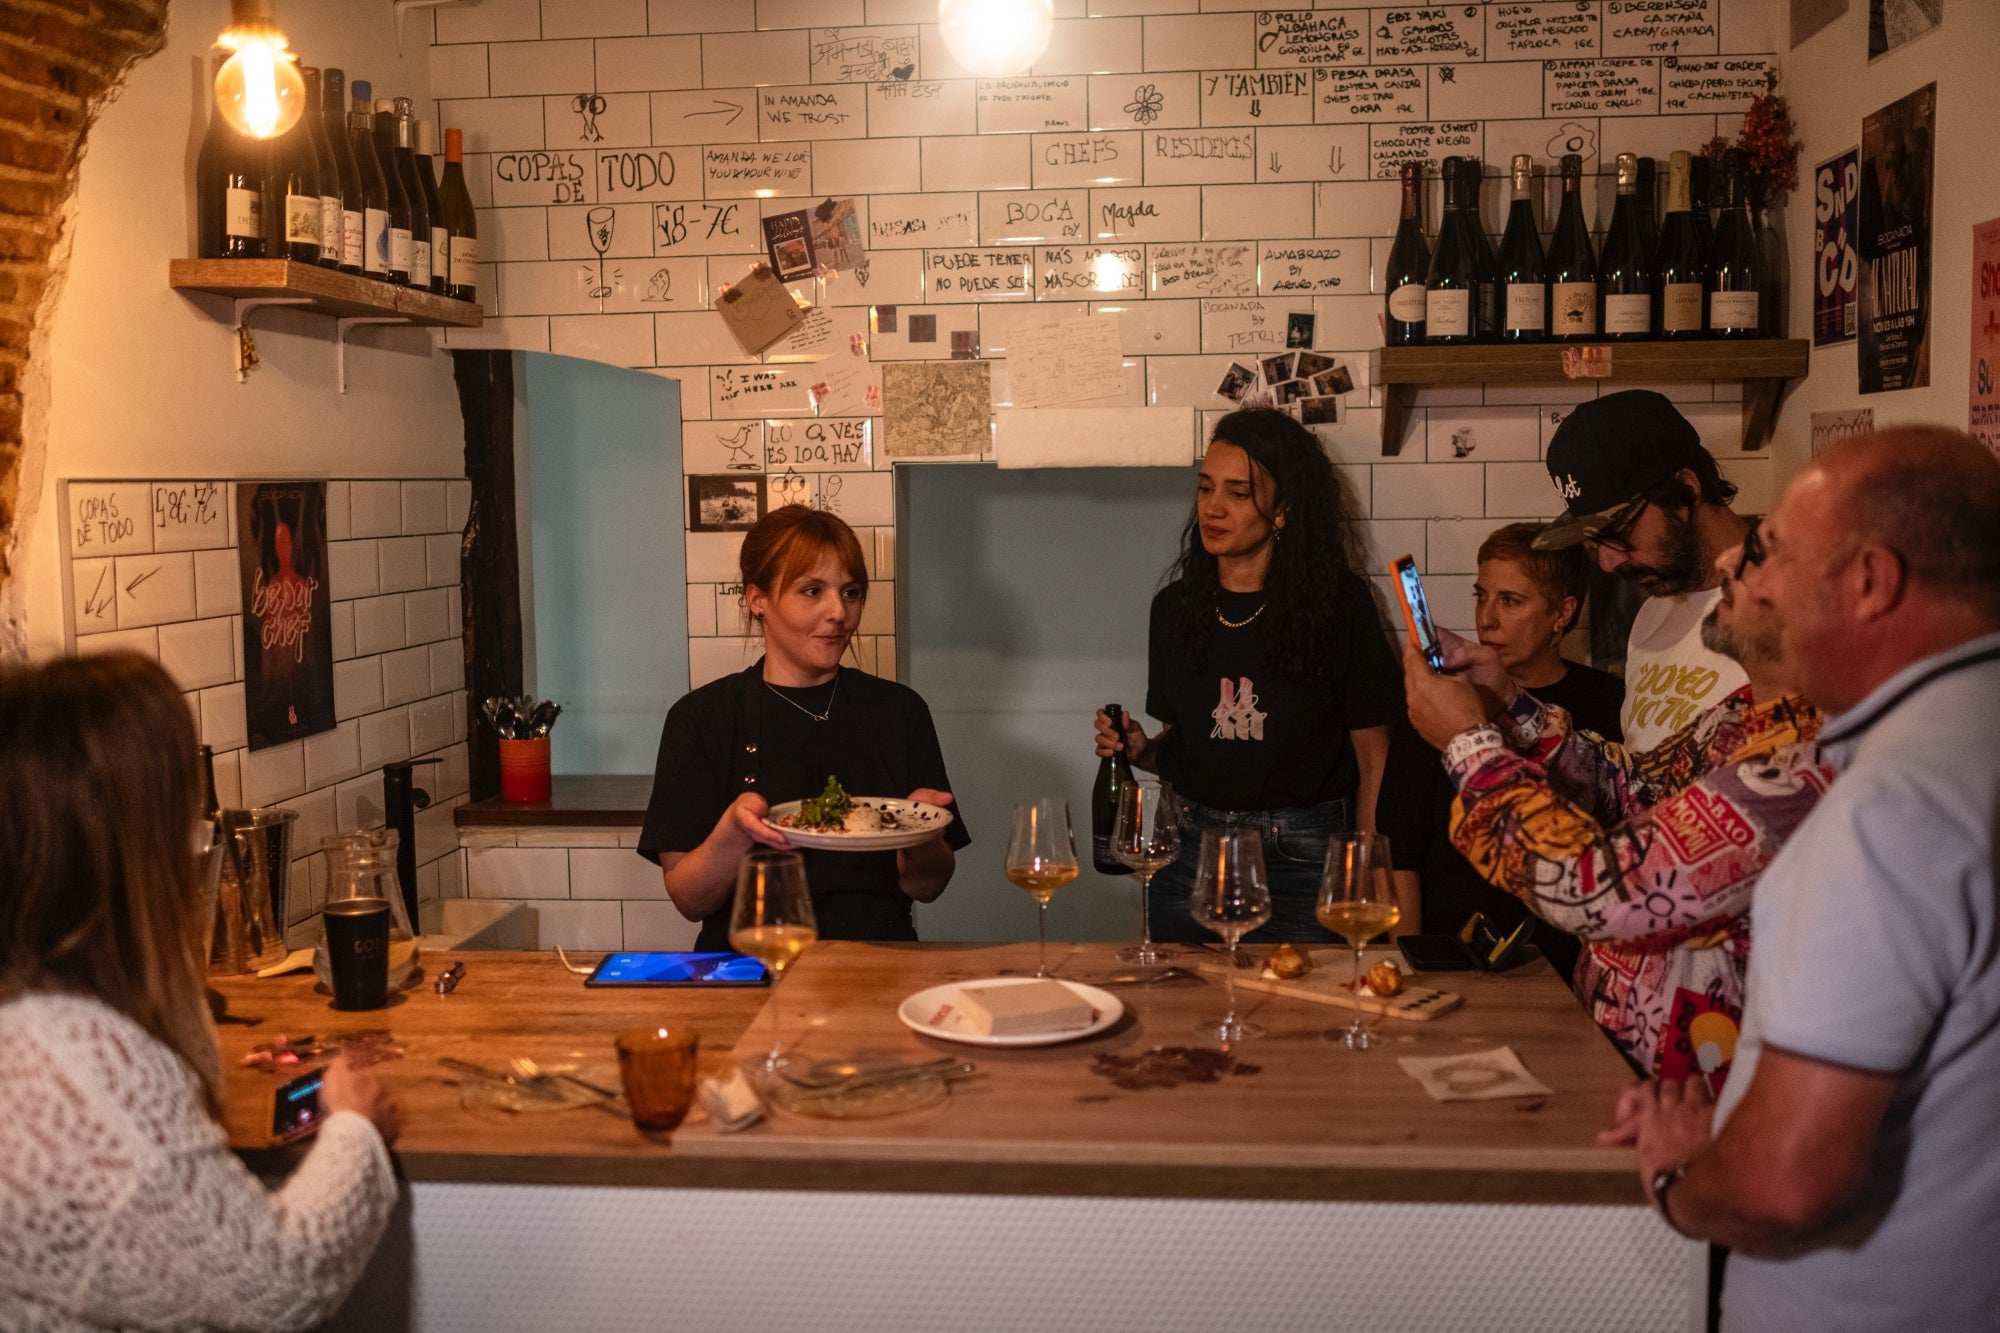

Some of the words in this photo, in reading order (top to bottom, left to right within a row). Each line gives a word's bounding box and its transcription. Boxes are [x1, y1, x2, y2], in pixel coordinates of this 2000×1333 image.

[1276, 12, 1313, 24] POLLO
[1647, 42, 1668, 52] TOP
[1594, 70, 1616, 78] COCO
[1206, 76, 1218, 96] Y
[765, 95, 774, 106] IN
[780, 93, 837, 106] AMANDA
[1351, 104, 1382, 114] OKRA
[767, 110, 791, 123] WE
[797, 112, 850, 125] TRUST
[1374, 137, 1430, 148] CHOCOLATE
[706, 150, 757, 163] AMANDA
[763, 152, 783, 163] WE
[1045, 136, 1118, 165] CHEFS
[497, 152, 584, 182] COPAS
[602, 151, 675, 192] TODO
[552, 179, 585, 203] DE
[1006, 198, 1073, 225] BOCA
[1103, 200, 1159, 241] Magda
[1265, 249, 1341, 260] ALMABRAZO
[1289, 264, 1304, 276] BY
[936, 278, 952, 292] NO
[960, 276, 1000, 292] PUEDE
[1203, 301, 1265, 315] BOCANADA
[1228, 330, 1285, 349] TETRIS
[754, 372, 777, 381] WAS
[744, 383, 773, 394] HERE
[767, 446, 787, 465] ES
[831, 441, 863, 465] HAY
[79, 492, 119, 523] COPAS
[77, 524, 92, 547] DE
[98, 517, 134, 544] TODO
